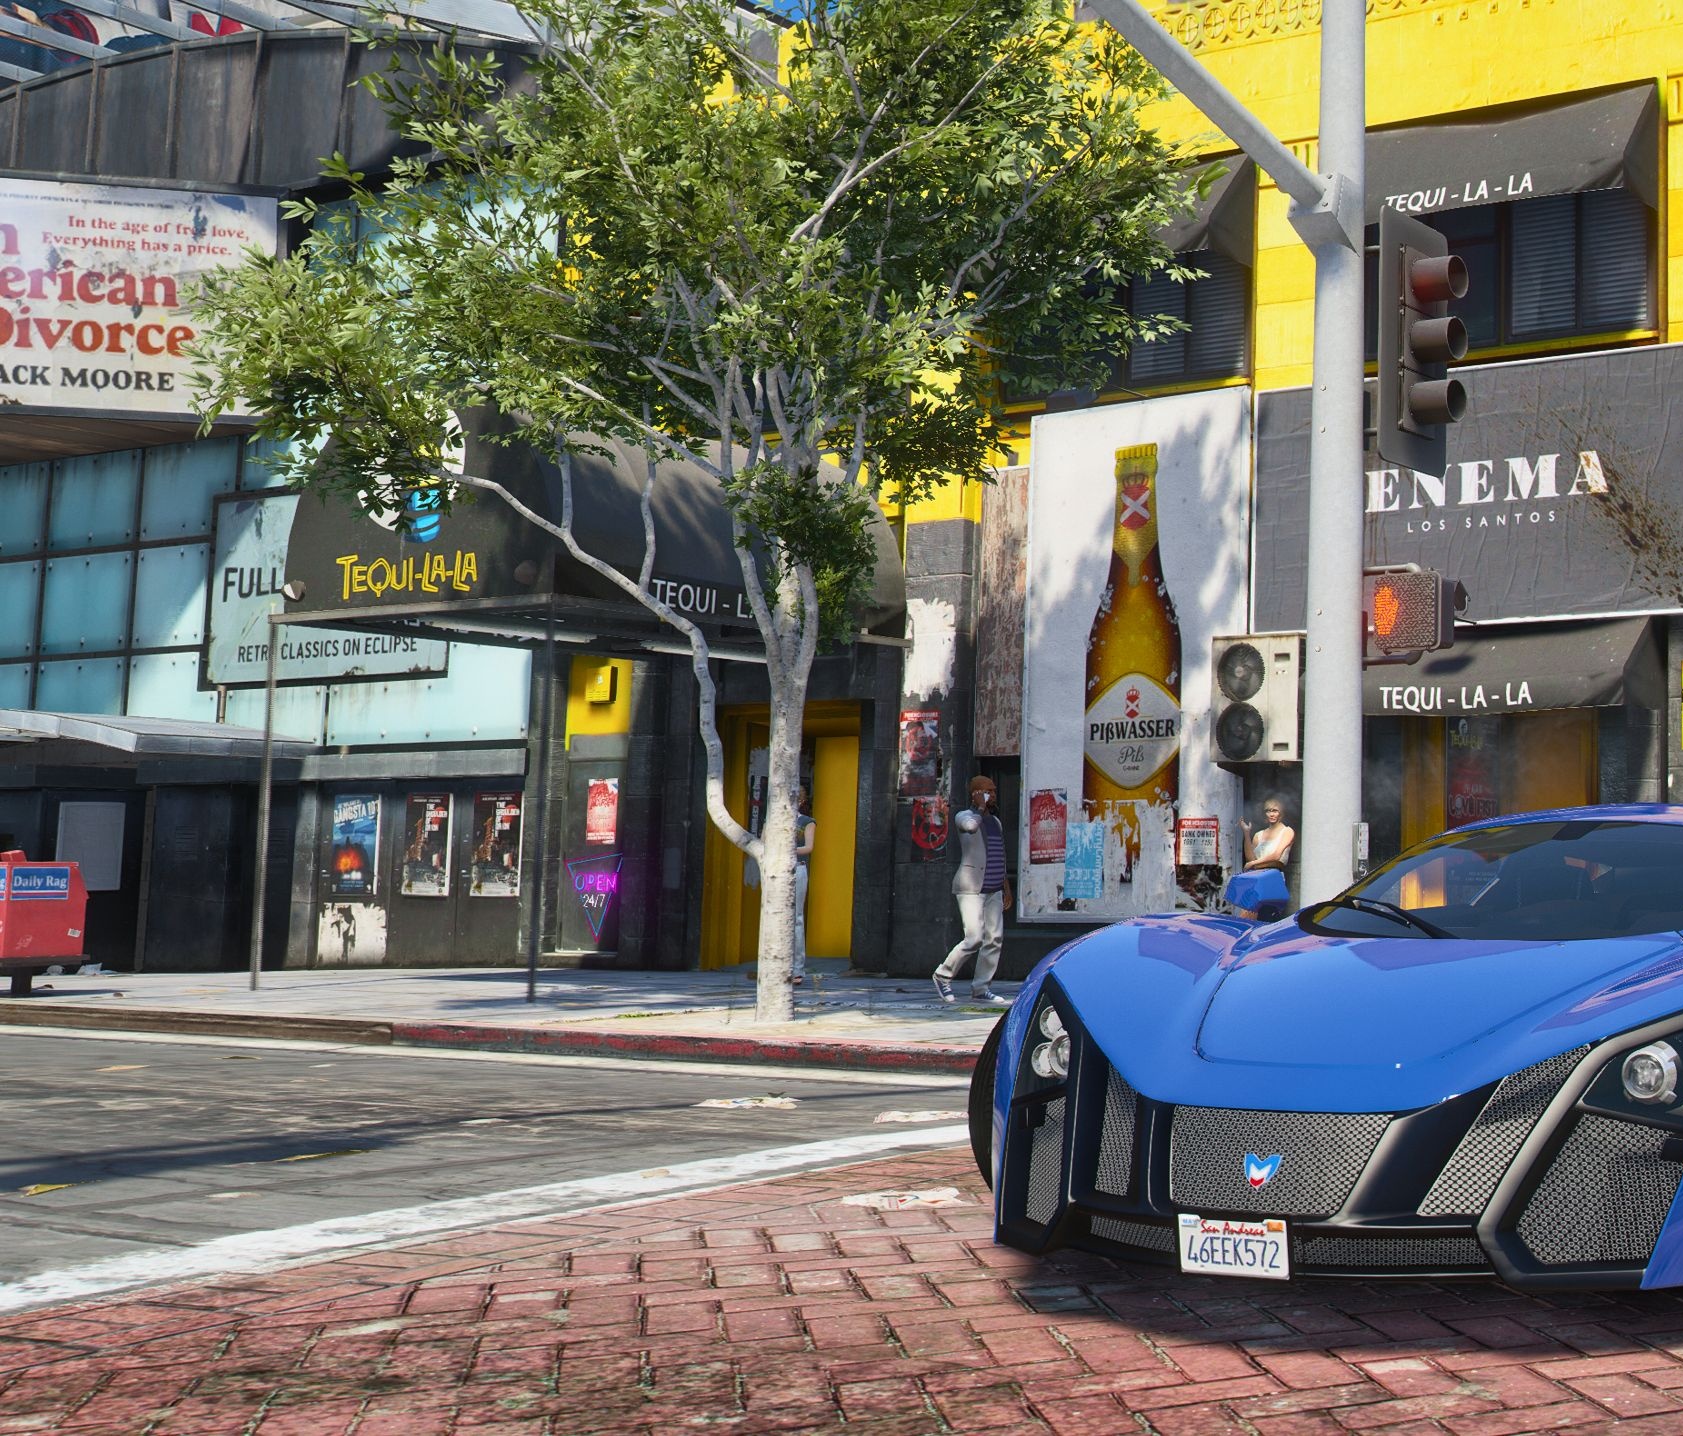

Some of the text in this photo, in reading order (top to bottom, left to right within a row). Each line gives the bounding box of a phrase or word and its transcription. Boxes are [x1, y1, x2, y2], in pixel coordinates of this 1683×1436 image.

[1385, 187, 1446, 213] TEQUI
[1464, 180, 1489, 203] LA
[1508, 172, 1534, 196] LA
[68, 215, 249, 242] In the age of free love,
[41, 231, 233, 256] Everything has a price.
[60, 365, 175, 392] MOORE
[1407, 511, 1557, 533] LOS SANTOS
[336, 550, 478, 600] TEQUI-LA-LA
[652, 578, 716, 613] TEQUI
[237, 635, 417, 664] RETR CLASSICS ON ECLIPSE
[1379, 686, 1441, 713] TEQUI
[1461, 684, 1487, 709] LA
[1505, 681, 1533, 706] LA
[1118, 745, 1145, 765] Pils
[1197, 830, 1215, 838] OWNED
[13, 875, 43, 889] Daily
[46, 876, 68, 889] Rag
[575, 872, 617, 892] OPEN
[583, 894, 606, 908] 24/7
[1200, 1219, 1266, 1236] San Andreas
[1187, 1235, 1281, 1269] 46EEK572
